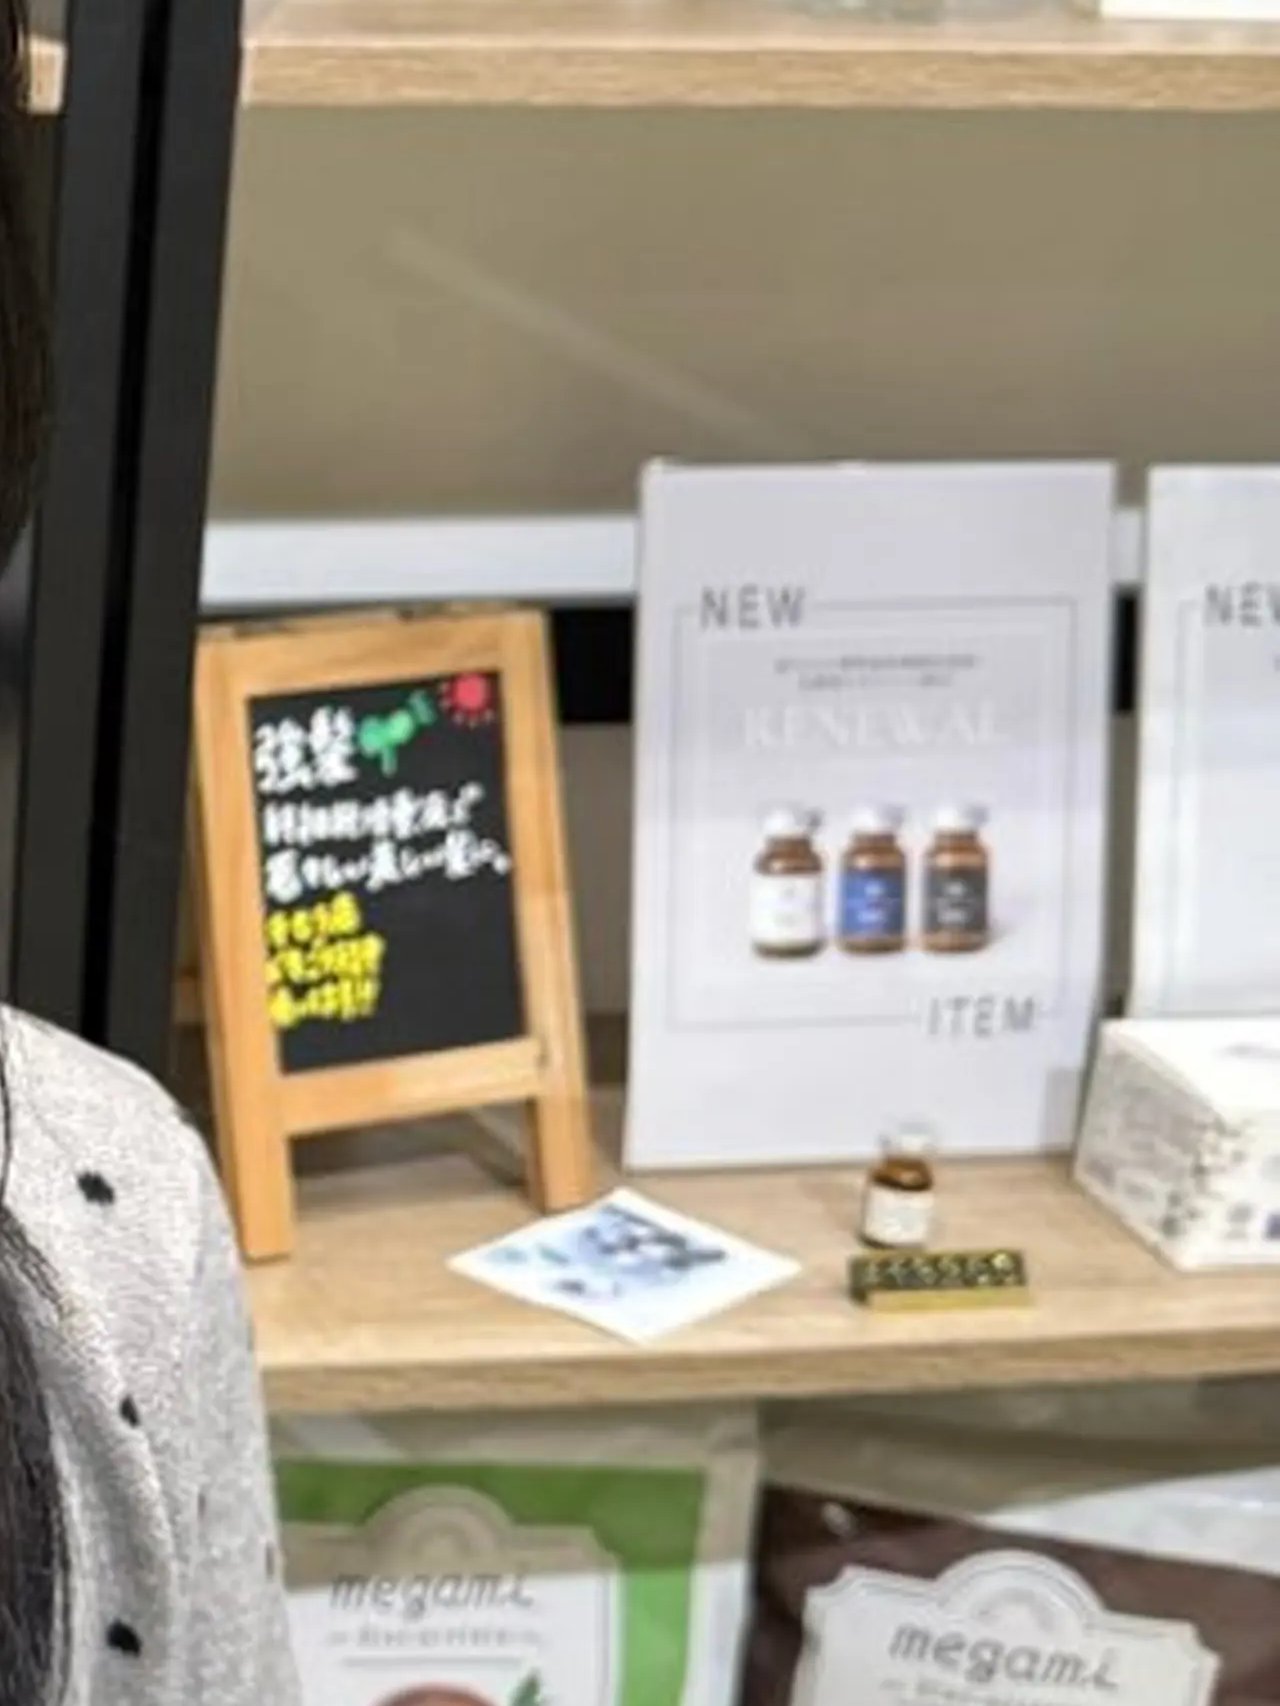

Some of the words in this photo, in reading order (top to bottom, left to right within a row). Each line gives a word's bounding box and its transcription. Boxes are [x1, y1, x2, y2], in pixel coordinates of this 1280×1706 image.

[699, 583, 805, 629] NEW
[928, 995, 1037, 1037] ITEM
[888, 1623, 1120, 1692] megami
